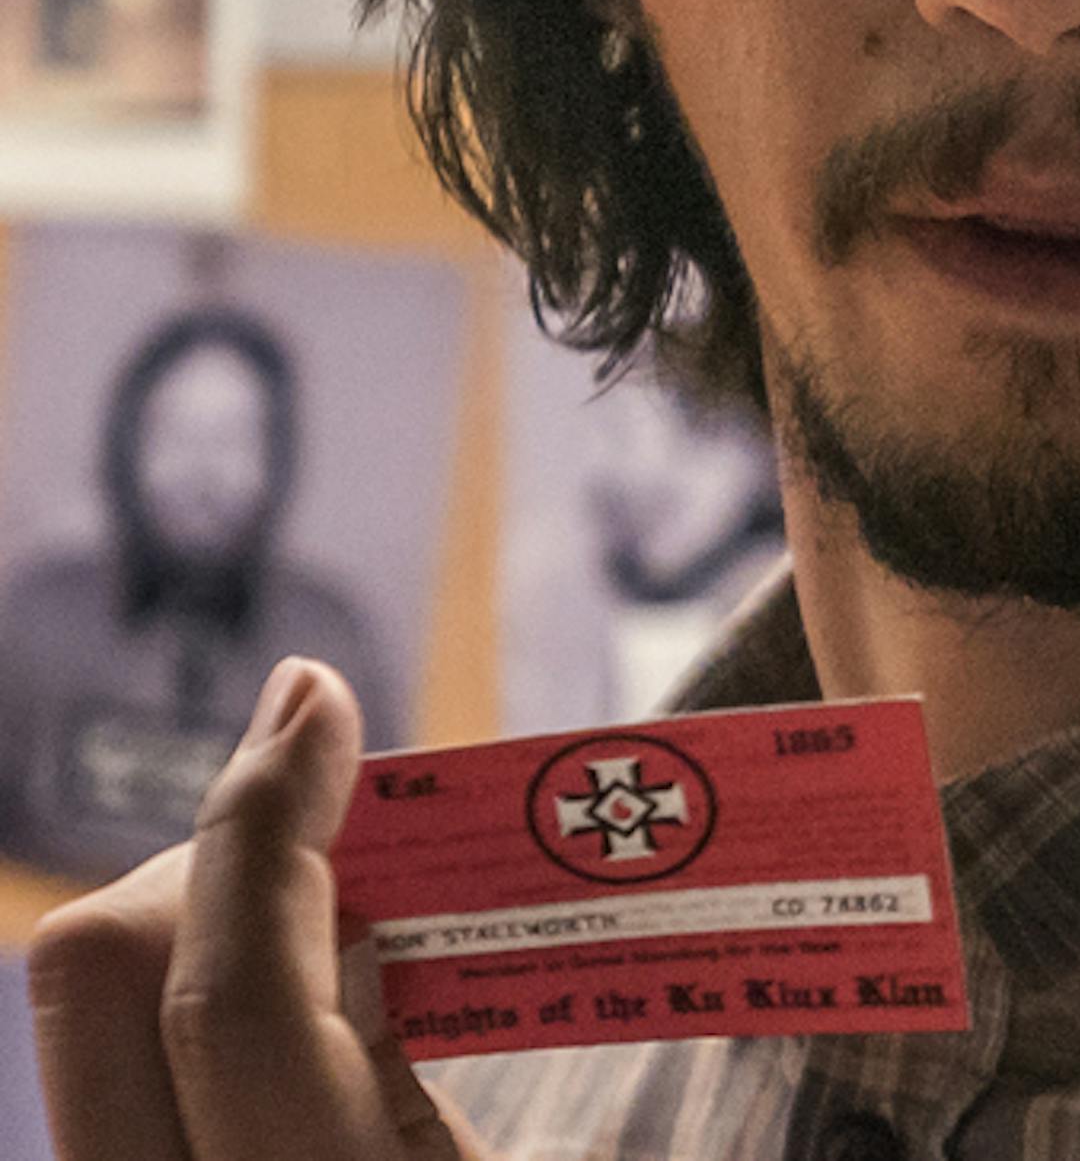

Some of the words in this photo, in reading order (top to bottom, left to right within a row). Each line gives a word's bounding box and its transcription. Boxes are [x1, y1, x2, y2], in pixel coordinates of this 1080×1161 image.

[388, 1003, 518, 1039] nights
[539, 994, 574, 1024] of
[594, 990, 647, 1022] the
[666, 983, 726, 1013] Ku
[744, 979, 837, 1009] Klux
[854, 974, 947, 1008] Klan
